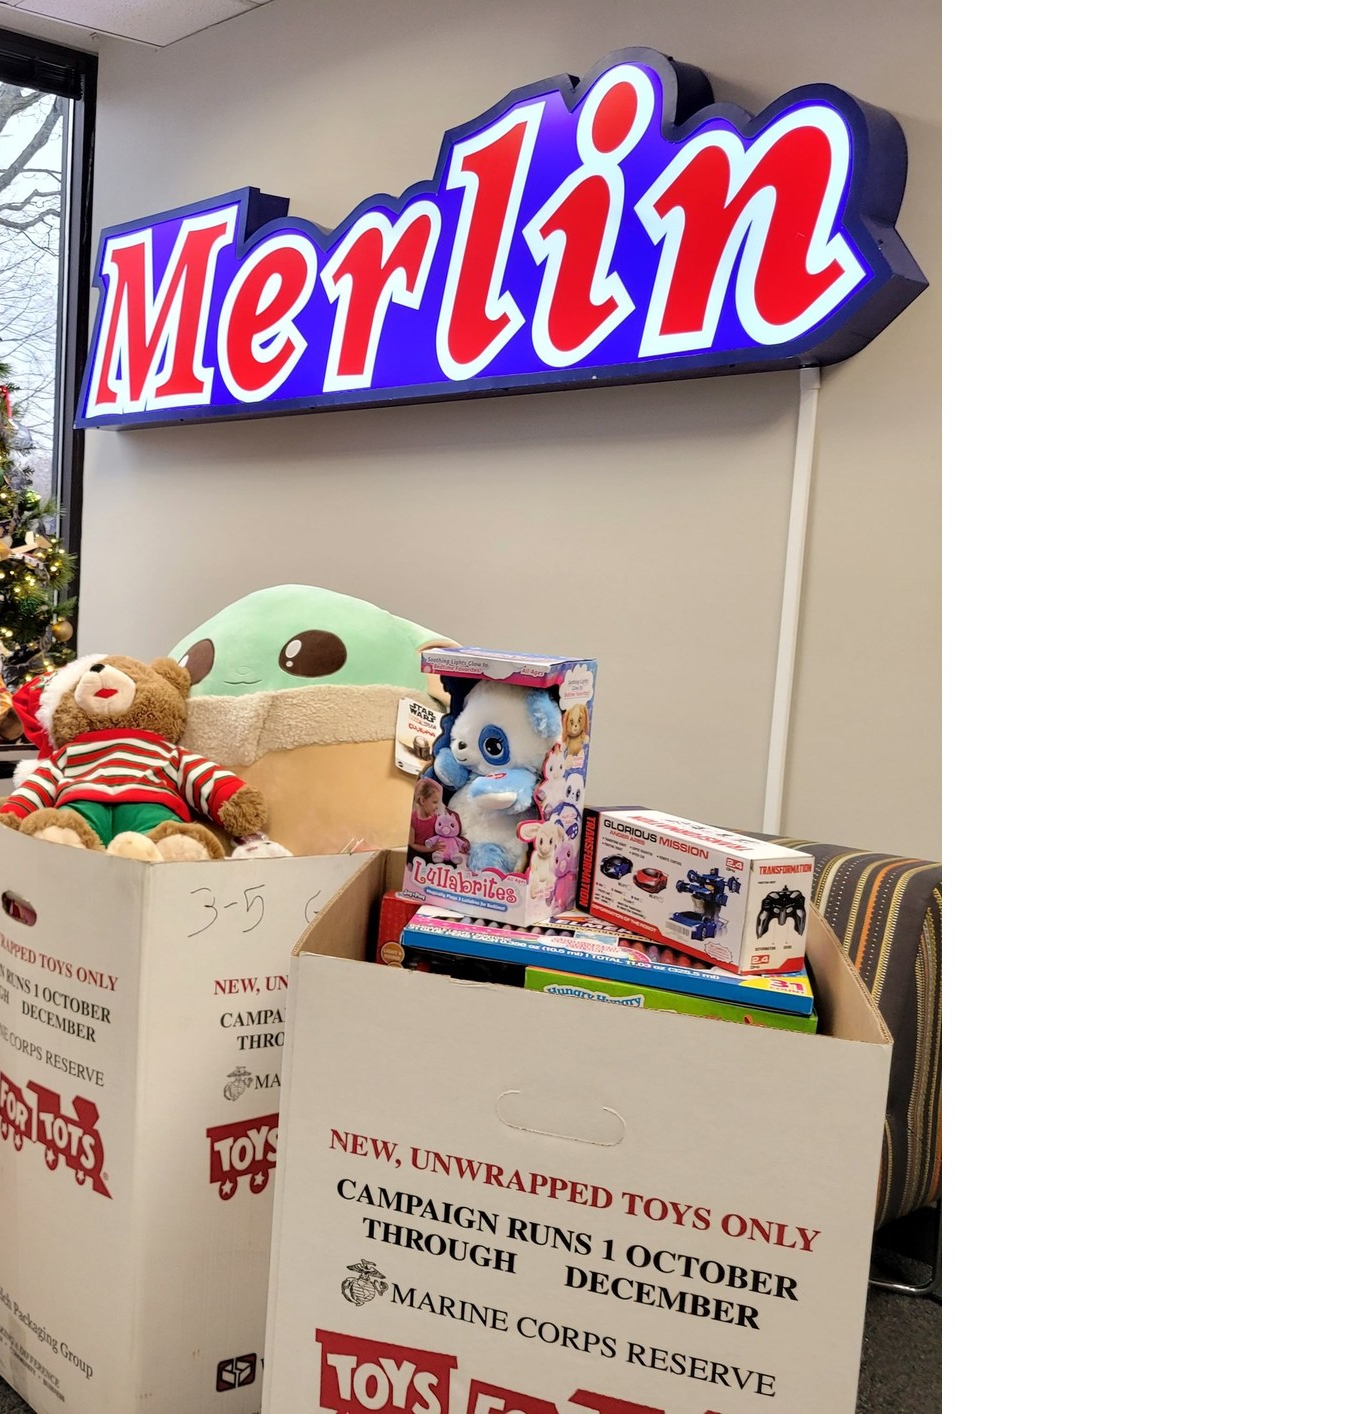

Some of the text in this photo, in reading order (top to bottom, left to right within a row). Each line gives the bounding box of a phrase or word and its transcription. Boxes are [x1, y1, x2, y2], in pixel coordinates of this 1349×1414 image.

[85, 63, 873, 416] Merlin
[521, 667, 544, 678] All Ages
[409, 702, 436, 719] STAR
[410, 708, 436, 723] WARS
[579, 816, 597, 908] TRANSFORMATION
[603, 819, 658, 843] GLORIOUS
[658, 836, 709, 860] MISSION
[413, 859, 518, 904] Lullabrites
[726, 858, 744, 870] 2.4
[759, 864, 812, 876] TRANSFORMATION
[187, 883, 266, 938] 3-5
[38, 953, 73, 979] TOYS
[76, 966, 119, 991] ONLY
[591, 955, 624, 964] TOTAL
[751, 955, 769, 964] 2.4
[6, 967, 31, 995] RUNS
[34, 983, 39, 998] 1
[42, 986, 111, 1024] OCTOBER
[214, 977, 260, 995] NEW,
[769, 979, 804, 991] 31
[21, 1000, 96, 1043] DECEMBER
[9, 1032, 42, 1061] CORPS
[45, 1050, 104, 1087] RESERVE
[1, 1079, 28, 1132] FOR
[39, 1112, 96, 1170] TOTS
[213, 1125, 279, 1172] TOYS
[330, 1127, 822, 1254] NEW, UNWRAPPED TOYS ONLY
[336, 1177, 799, 1302] CAMPAIGN RUNS 1 OCTOBER
[362, 1216, 761, 1331] THROUGH DECEMBER
[13, 1302, 59, 1354] Packaging
[59, 1342, 94, 1380] Group
[390, 1286, 777, 1398] MARINE CORPS RESERVE
[19, 1346, 60, 1389] DIFFERENCE
[326, 1353, 442, 1414] TOYS
